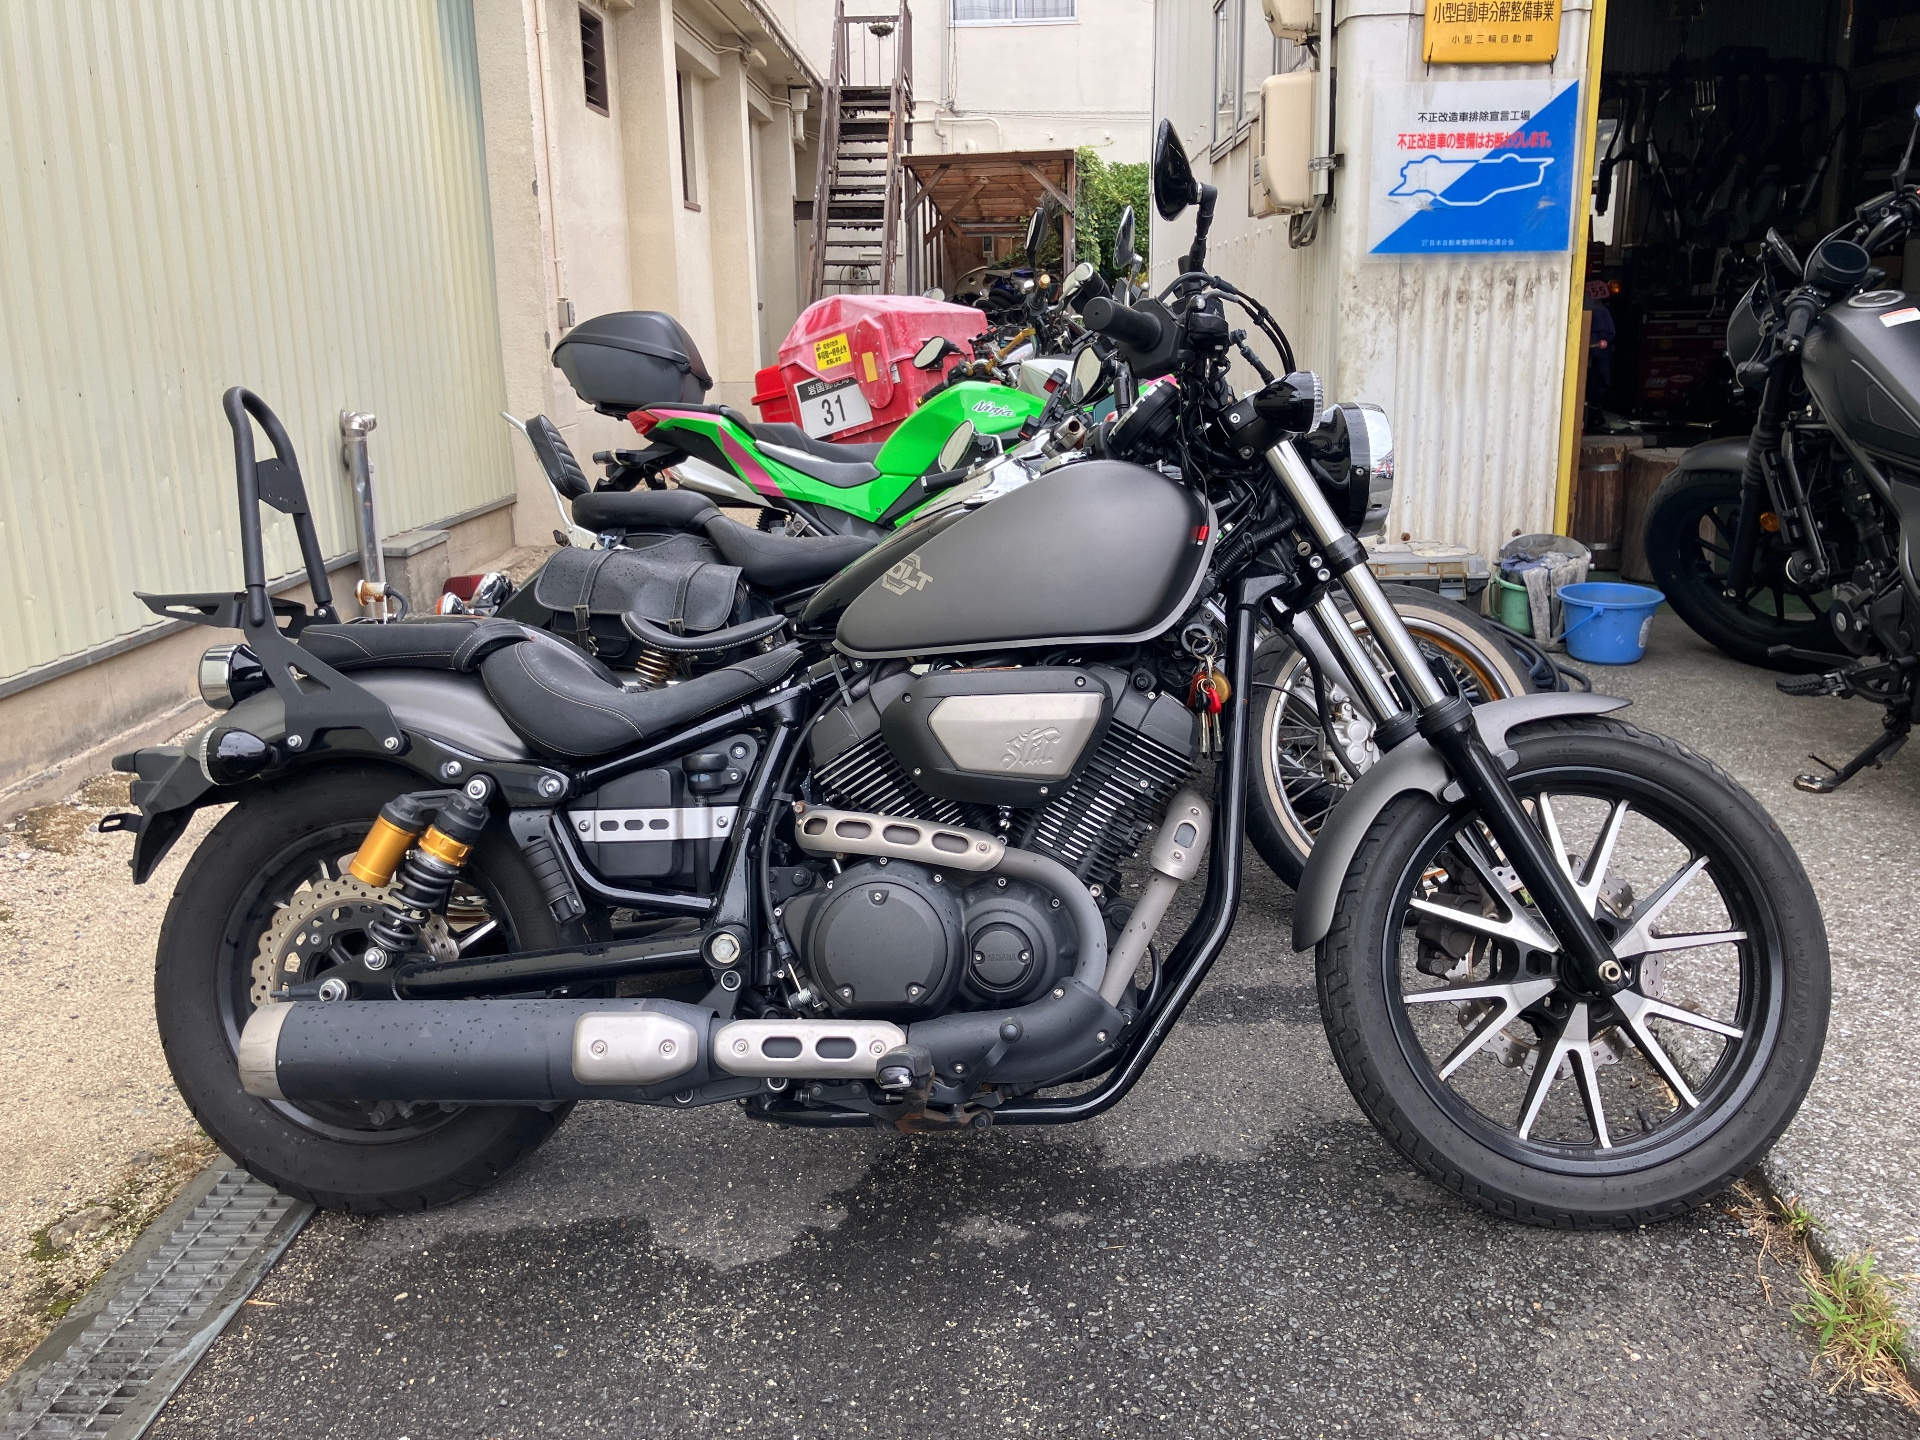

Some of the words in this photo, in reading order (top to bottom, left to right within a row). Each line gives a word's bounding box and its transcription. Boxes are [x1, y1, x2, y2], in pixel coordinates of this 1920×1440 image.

[1433, 1, 1554, 23] 小型自動車分解整備事業
[1451, 34, 1534, 44] 小型二輪自動車
[1417, 110, 1531, 123] 不正改造車排除宣言工場
[821, 394, 846, 427] 31
[972, 400, 1016, 418] Ninja
